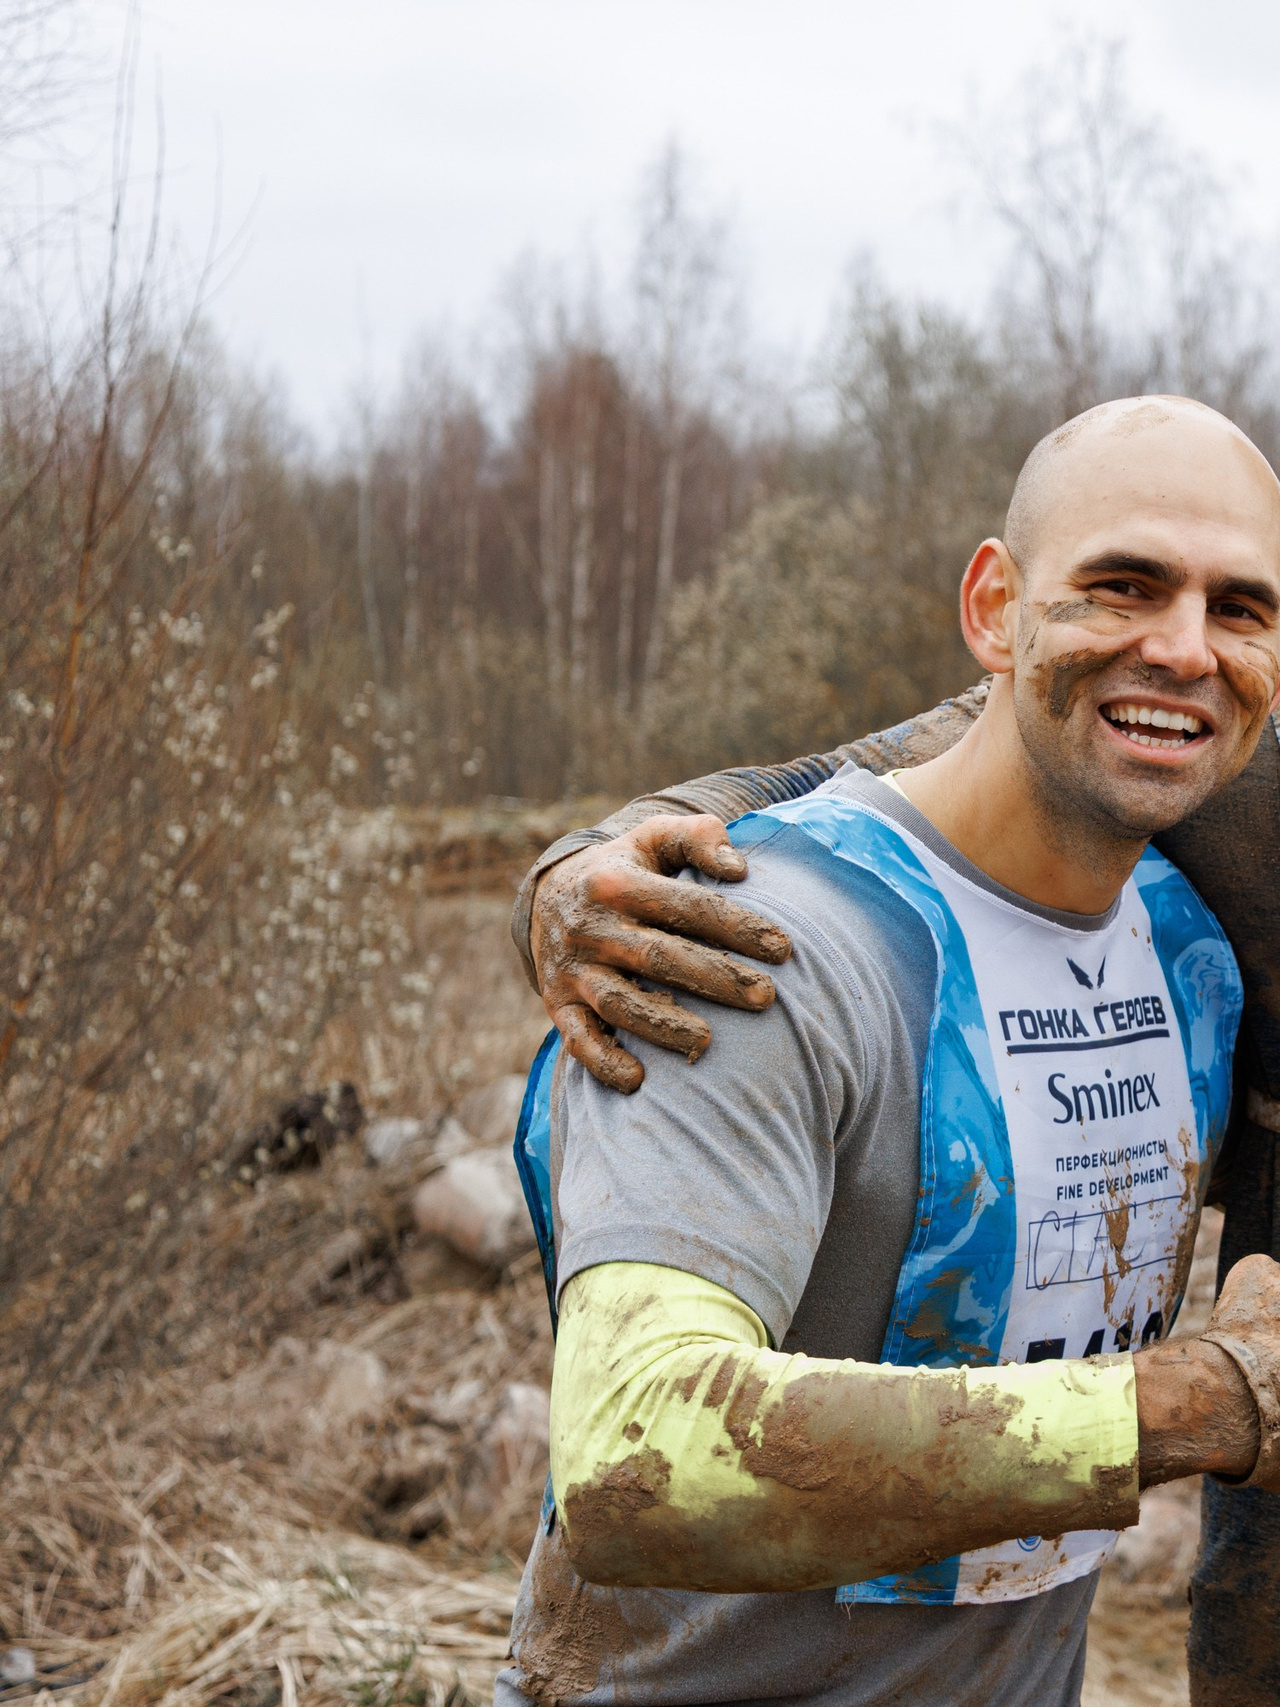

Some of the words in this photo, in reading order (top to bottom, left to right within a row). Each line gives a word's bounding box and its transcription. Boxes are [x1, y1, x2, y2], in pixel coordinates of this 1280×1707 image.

[999, 1008, 1090, 1041] ГОНКА
[1093, 995, 1167, 1035] ГЕРОЕВ
[1047, 1068, 1161, 1125] Sminex
[1055, 1140, 1168, 1172] ПЕРФЕКЦИОНИСТЫ
[1056, 1186, 1084, 1201] FINE
[1089, 1166, 1169, 1196] DEVELOPMENT
